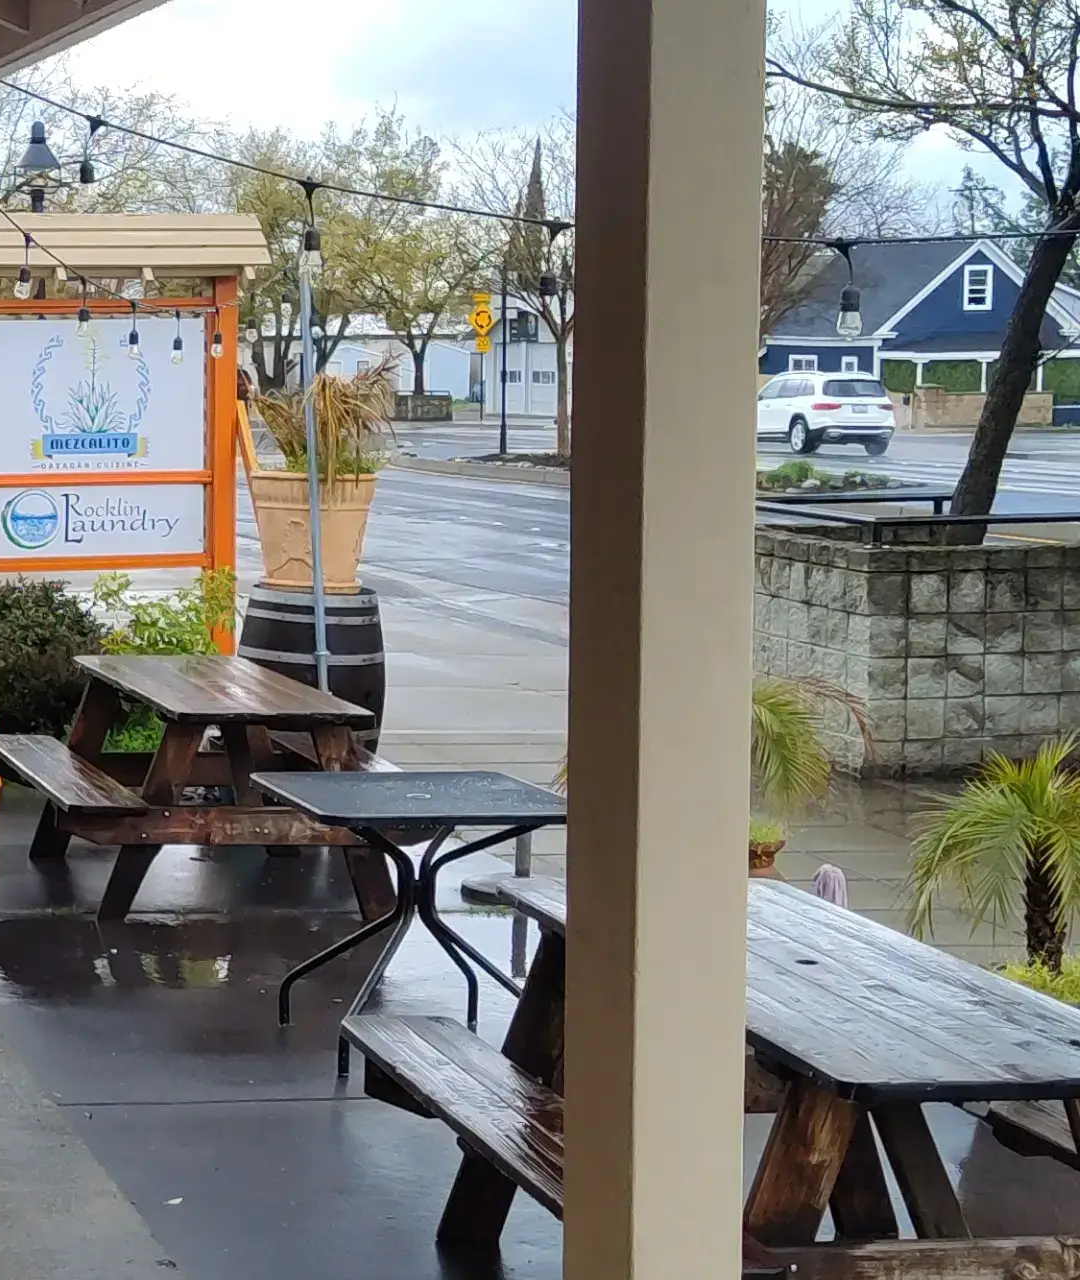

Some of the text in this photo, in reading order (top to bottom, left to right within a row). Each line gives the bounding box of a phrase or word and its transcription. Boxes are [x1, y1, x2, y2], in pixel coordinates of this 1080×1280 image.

[50, 437, 130, 450] MEZCALITO
[60, 493, 140, 518] Rocklin
[64, 509, 180, 544] Laundry
